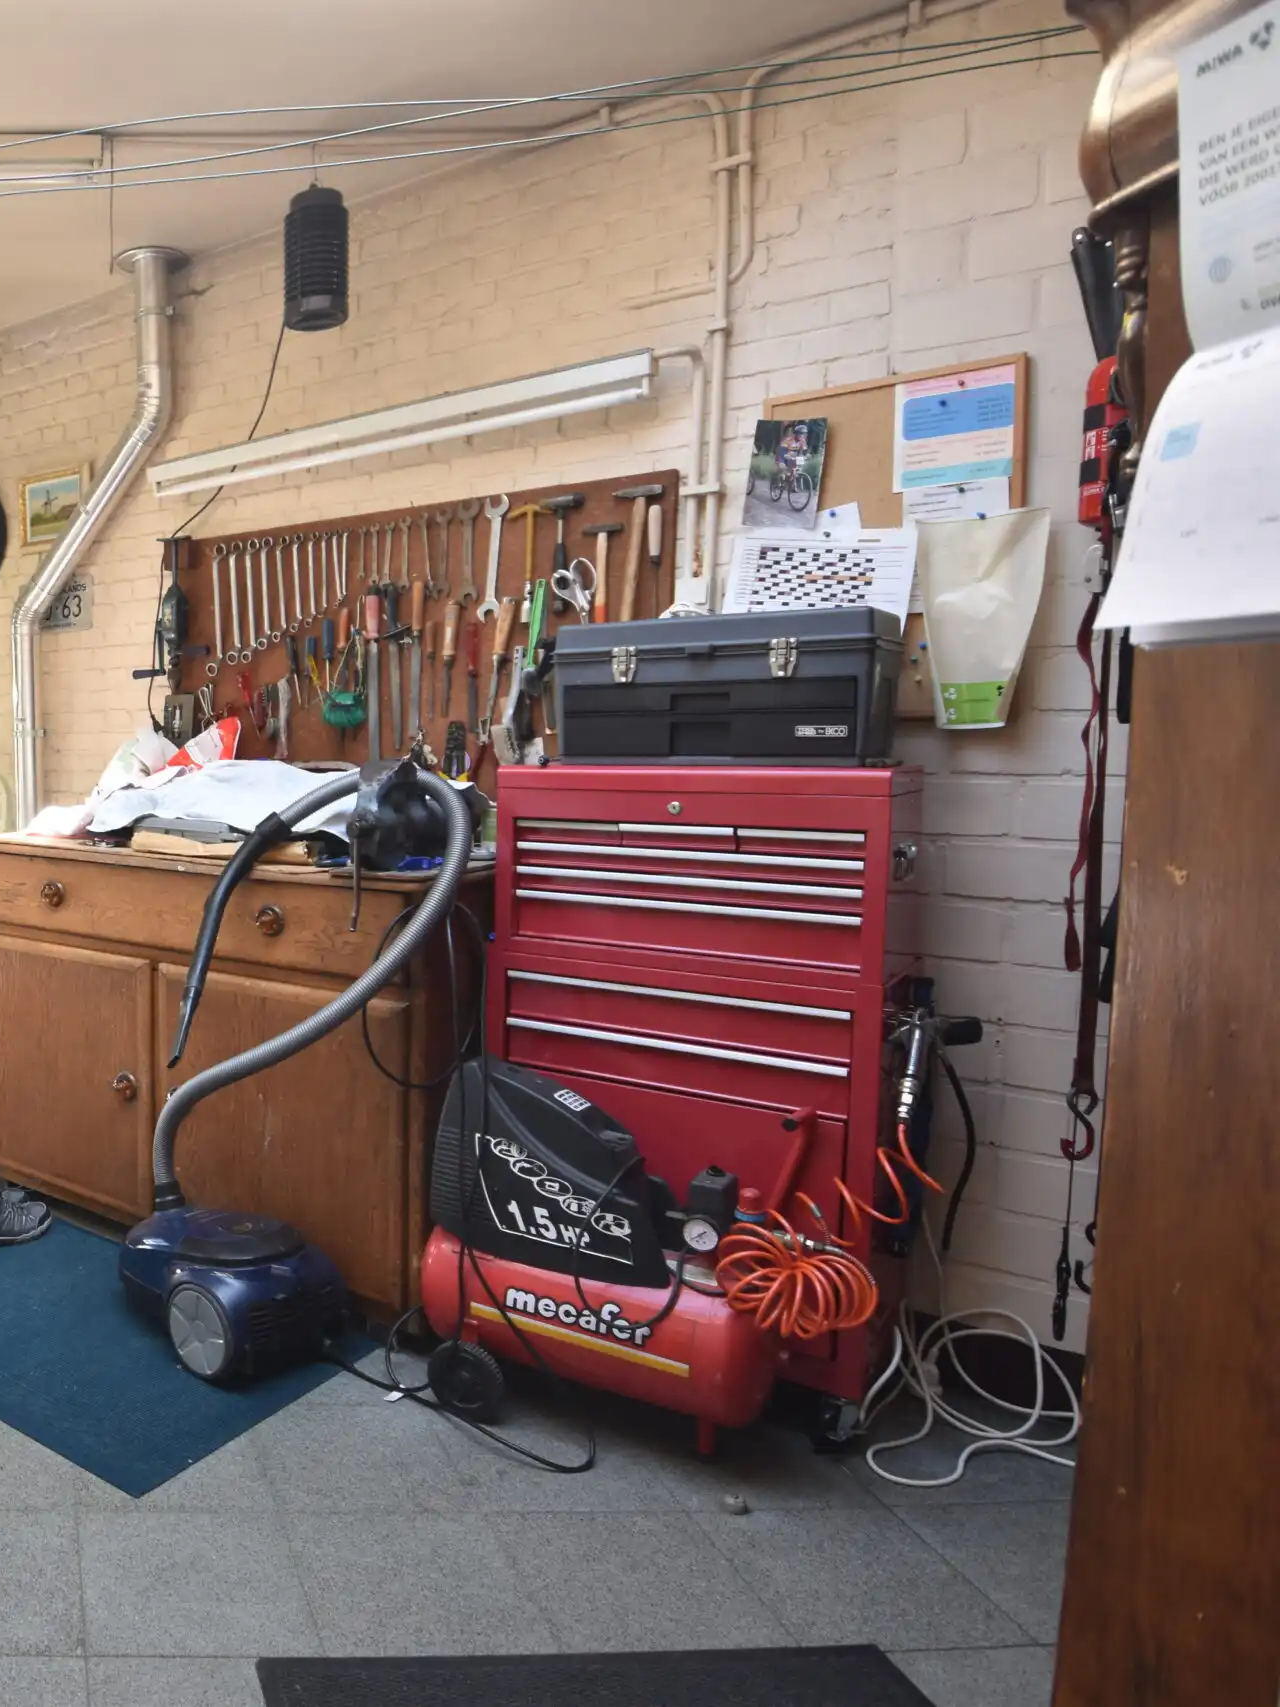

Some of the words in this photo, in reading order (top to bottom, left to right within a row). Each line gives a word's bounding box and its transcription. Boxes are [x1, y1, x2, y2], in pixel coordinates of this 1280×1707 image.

[1199, 132, 1227, 154] BEN
[1199, 149, 1228, 171] VAN
[1232, 133, 1260, 157] EEN
[506, 1200, 558, 1240] 1.5
[506, 1288, 652, 1345] mecafer
